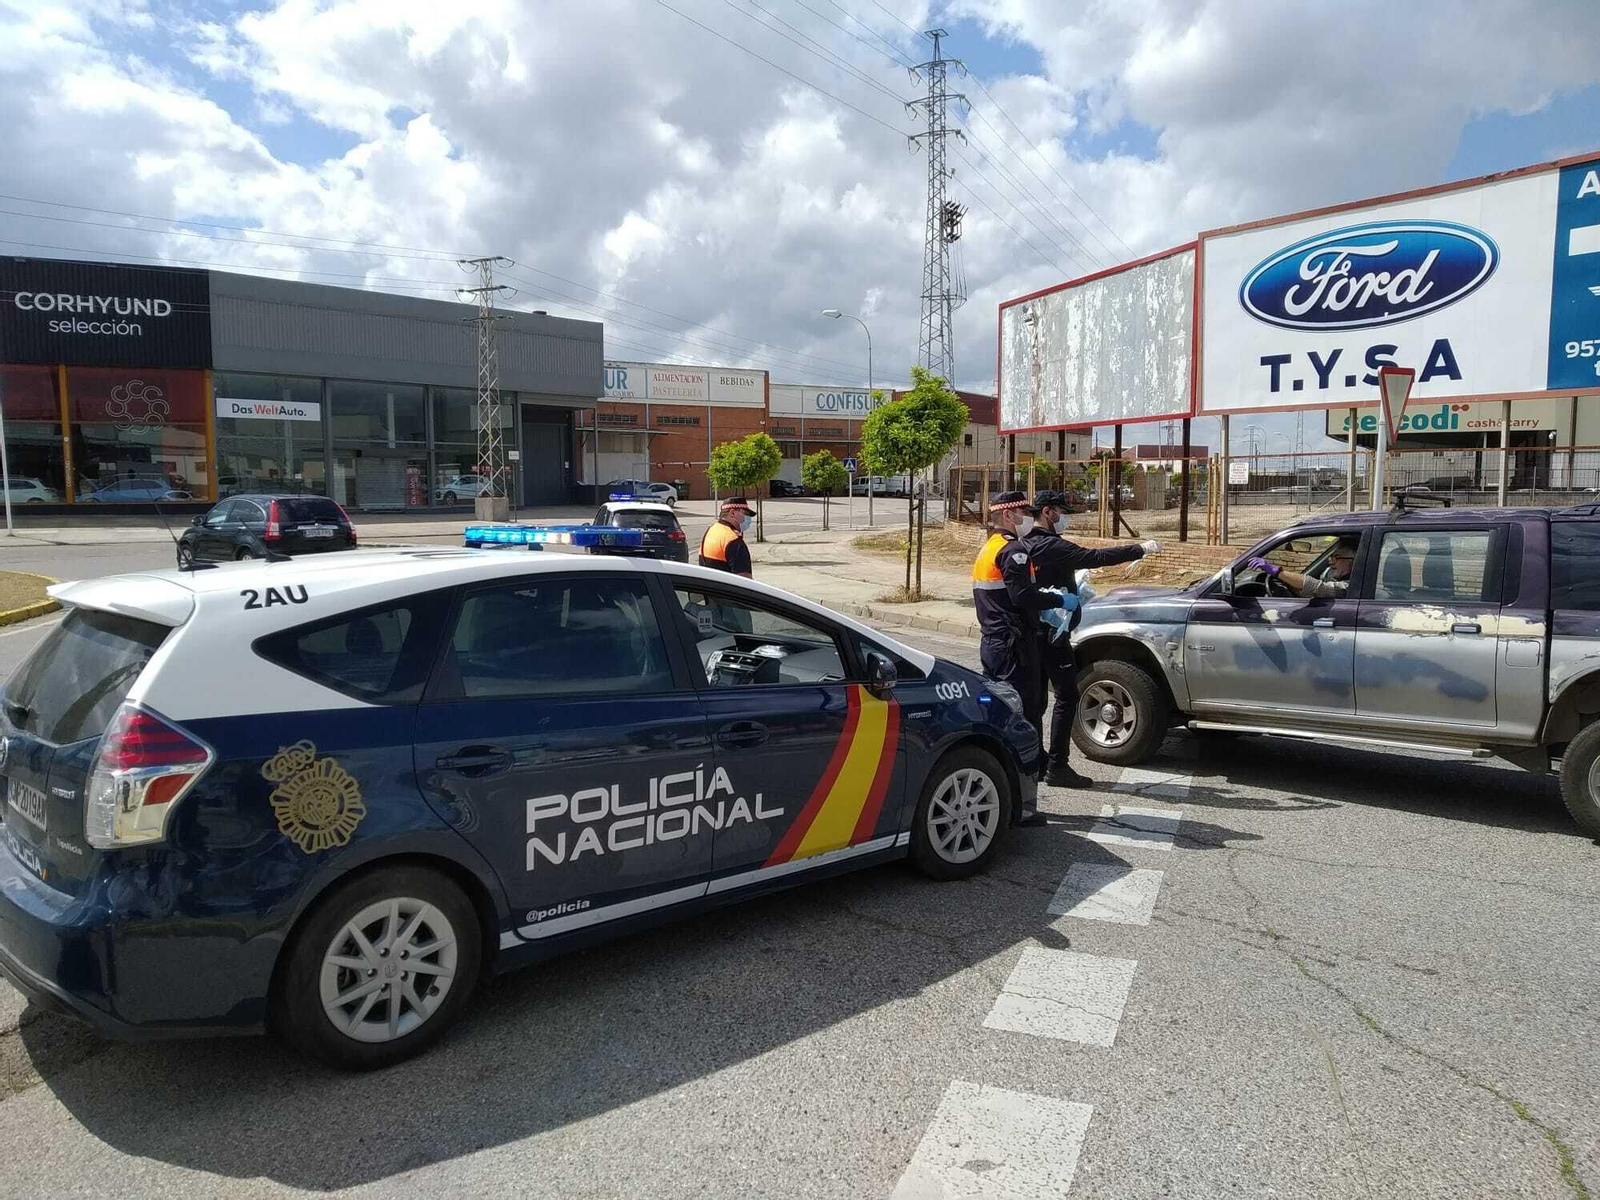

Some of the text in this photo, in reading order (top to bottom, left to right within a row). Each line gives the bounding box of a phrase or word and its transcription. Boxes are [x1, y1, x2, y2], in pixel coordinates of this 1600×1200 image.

[1284, 239, 1440, 316] Ford
[14, 291, 172, 317] CORHYUND
[48, 316, 142, 336] selección
[1260, 338, 1462, 393] T.Y.SA
[719, 376, 755, 387] BEBIDAS
[231, 403, 307, 417] Das WeltAuto.
[1342, 404, 1460, 432] secodi
[239, 584, 309, 610] 2AU
[941, 680, 971, 700] 091
[526, 762, 735, 834] POLICÍA
[526, 792, 785, 872] NACIONAL
[525, 900, 591, 923] @policia
